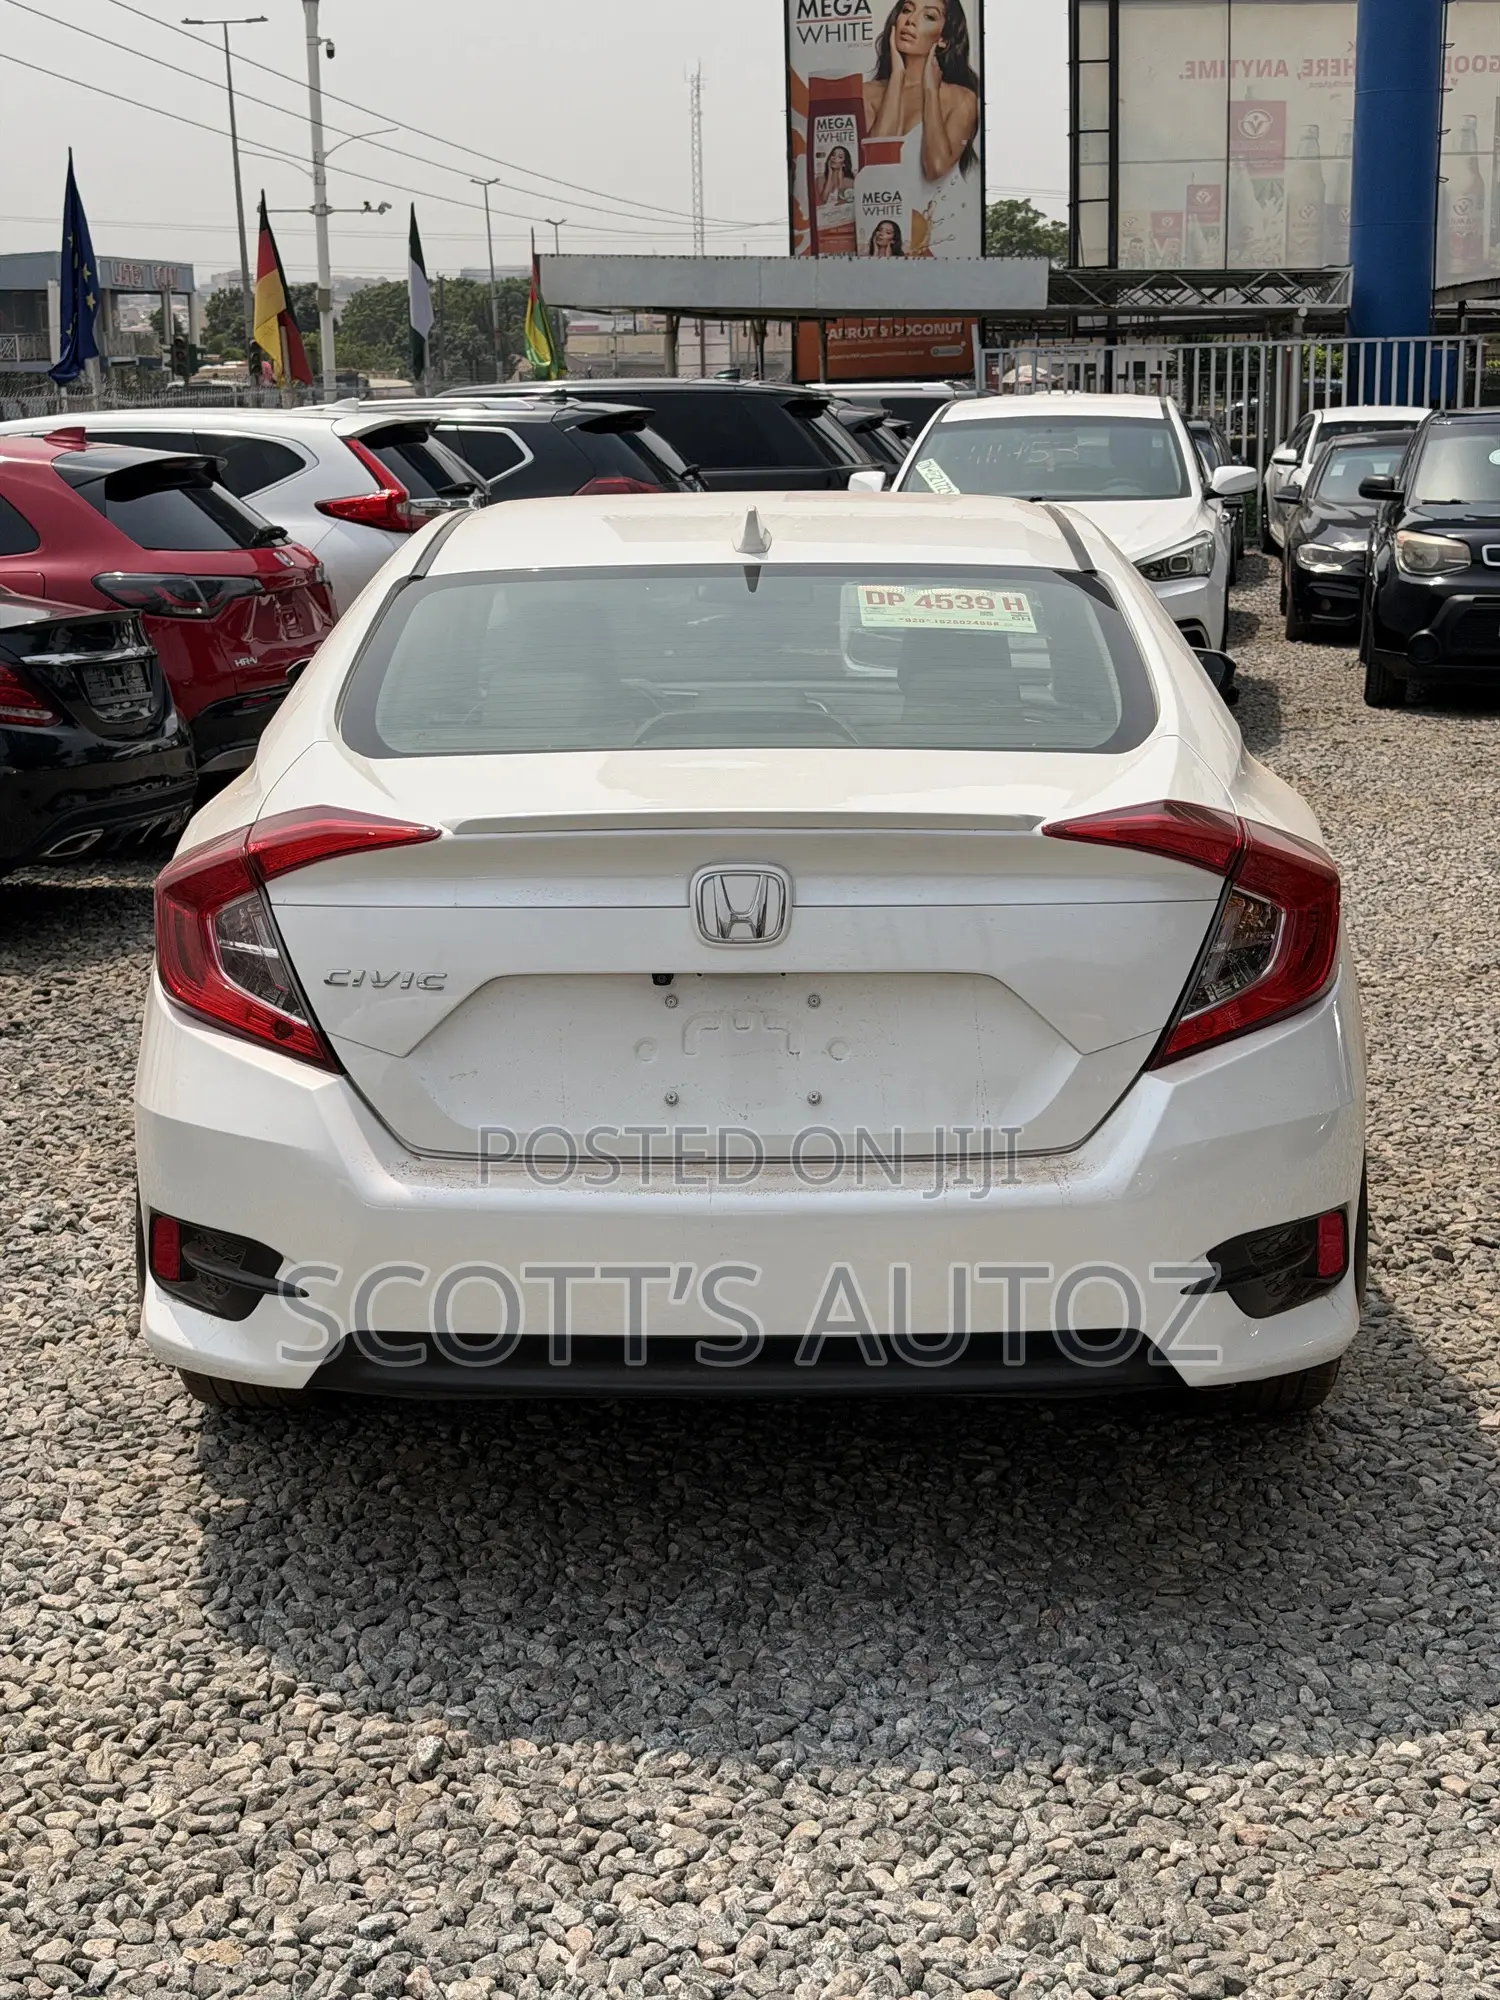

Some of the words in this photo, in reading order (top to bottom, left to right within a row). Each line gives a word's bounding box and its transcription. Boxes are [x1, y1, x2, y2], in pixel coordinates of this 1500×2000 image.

[797, 0, 872, 19] MEGA
[796, 21, 873, 45] WHITE
[816, 117, 854, 130] MEGA
[816, 131, 855, 143] WHITE
[862, 190, 902, 204] MEGA
[862, 204, 903, 216] WHITE
[890, 322, 963, 336] COCONUT
[865, 590, 906, 606] DP
[914, 594, 996, 610] 4539
[1001, 596, 1026, 611] H
[323, 968, 448, 991] CIVIC
